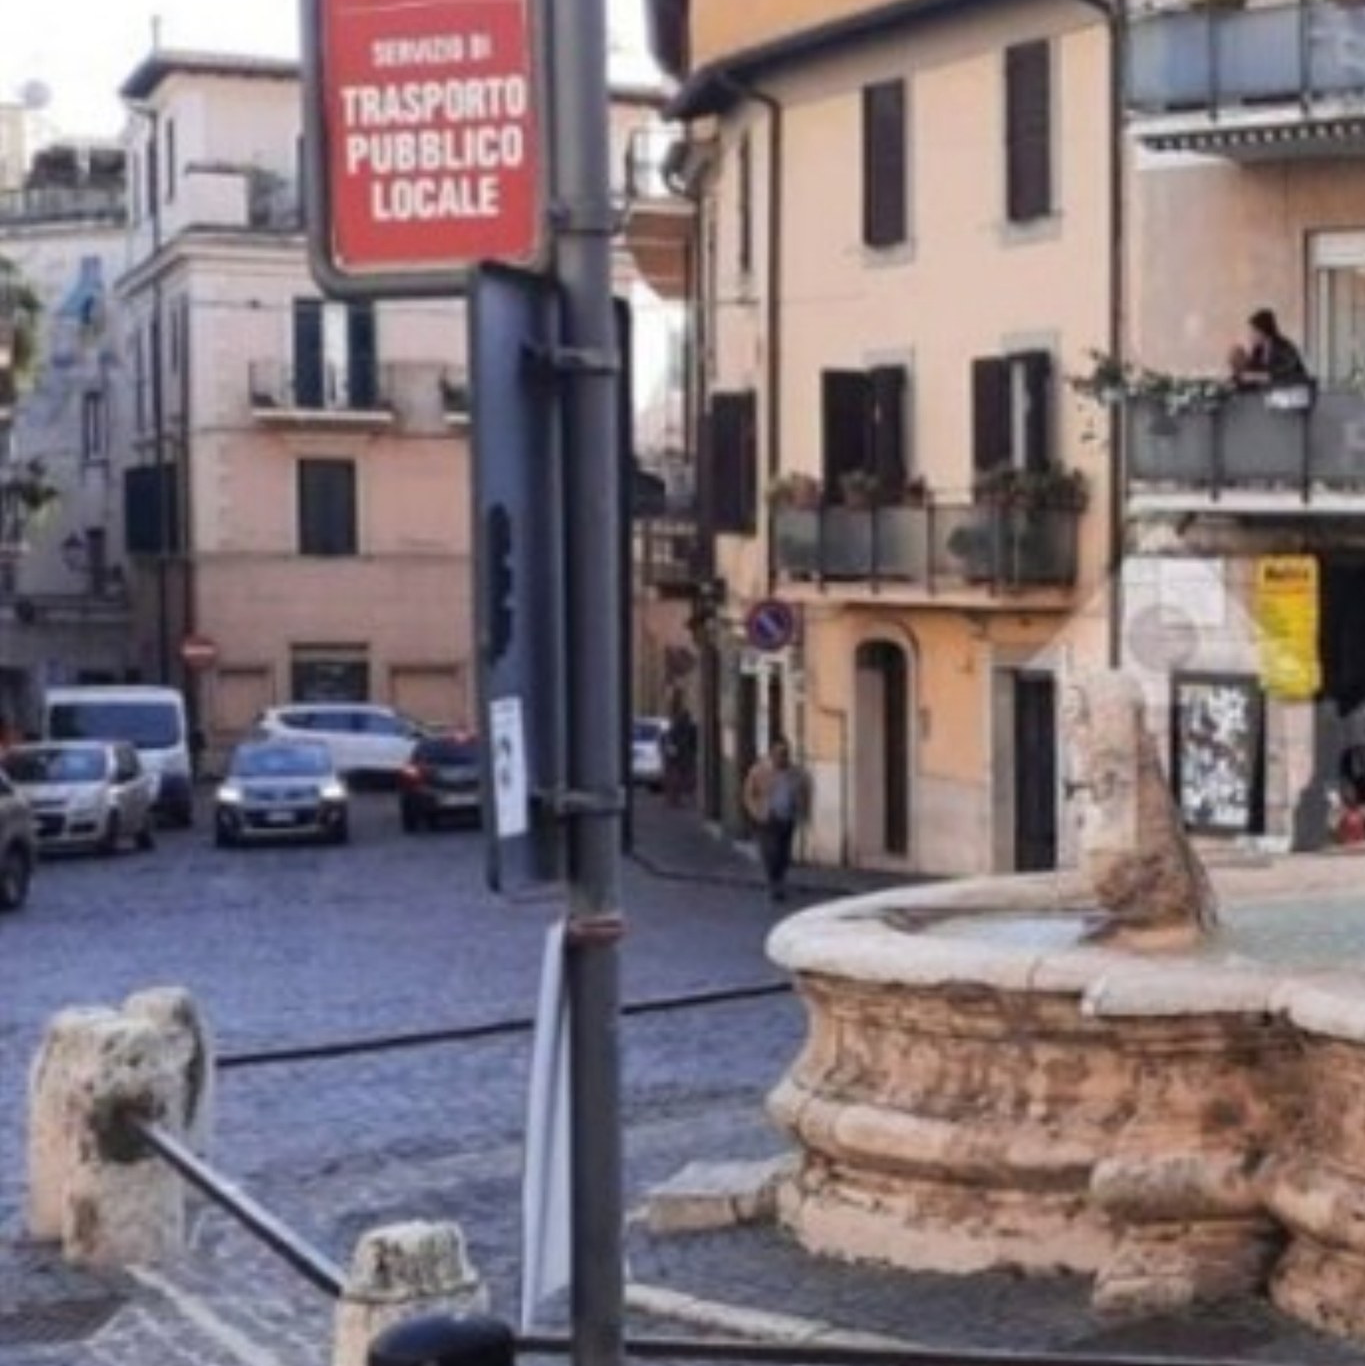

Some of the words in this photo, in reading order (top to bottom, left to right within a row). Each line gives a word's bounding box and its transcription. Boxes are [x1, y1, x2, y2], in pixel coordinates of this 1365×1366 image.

[371, 35, 464, 68] SERVIZIO
[341, 76, 528, 128] TRASPORTO
[346, 124, 524, 175] PUBBLICO
[371, 175, 500, 222] LOCALE
